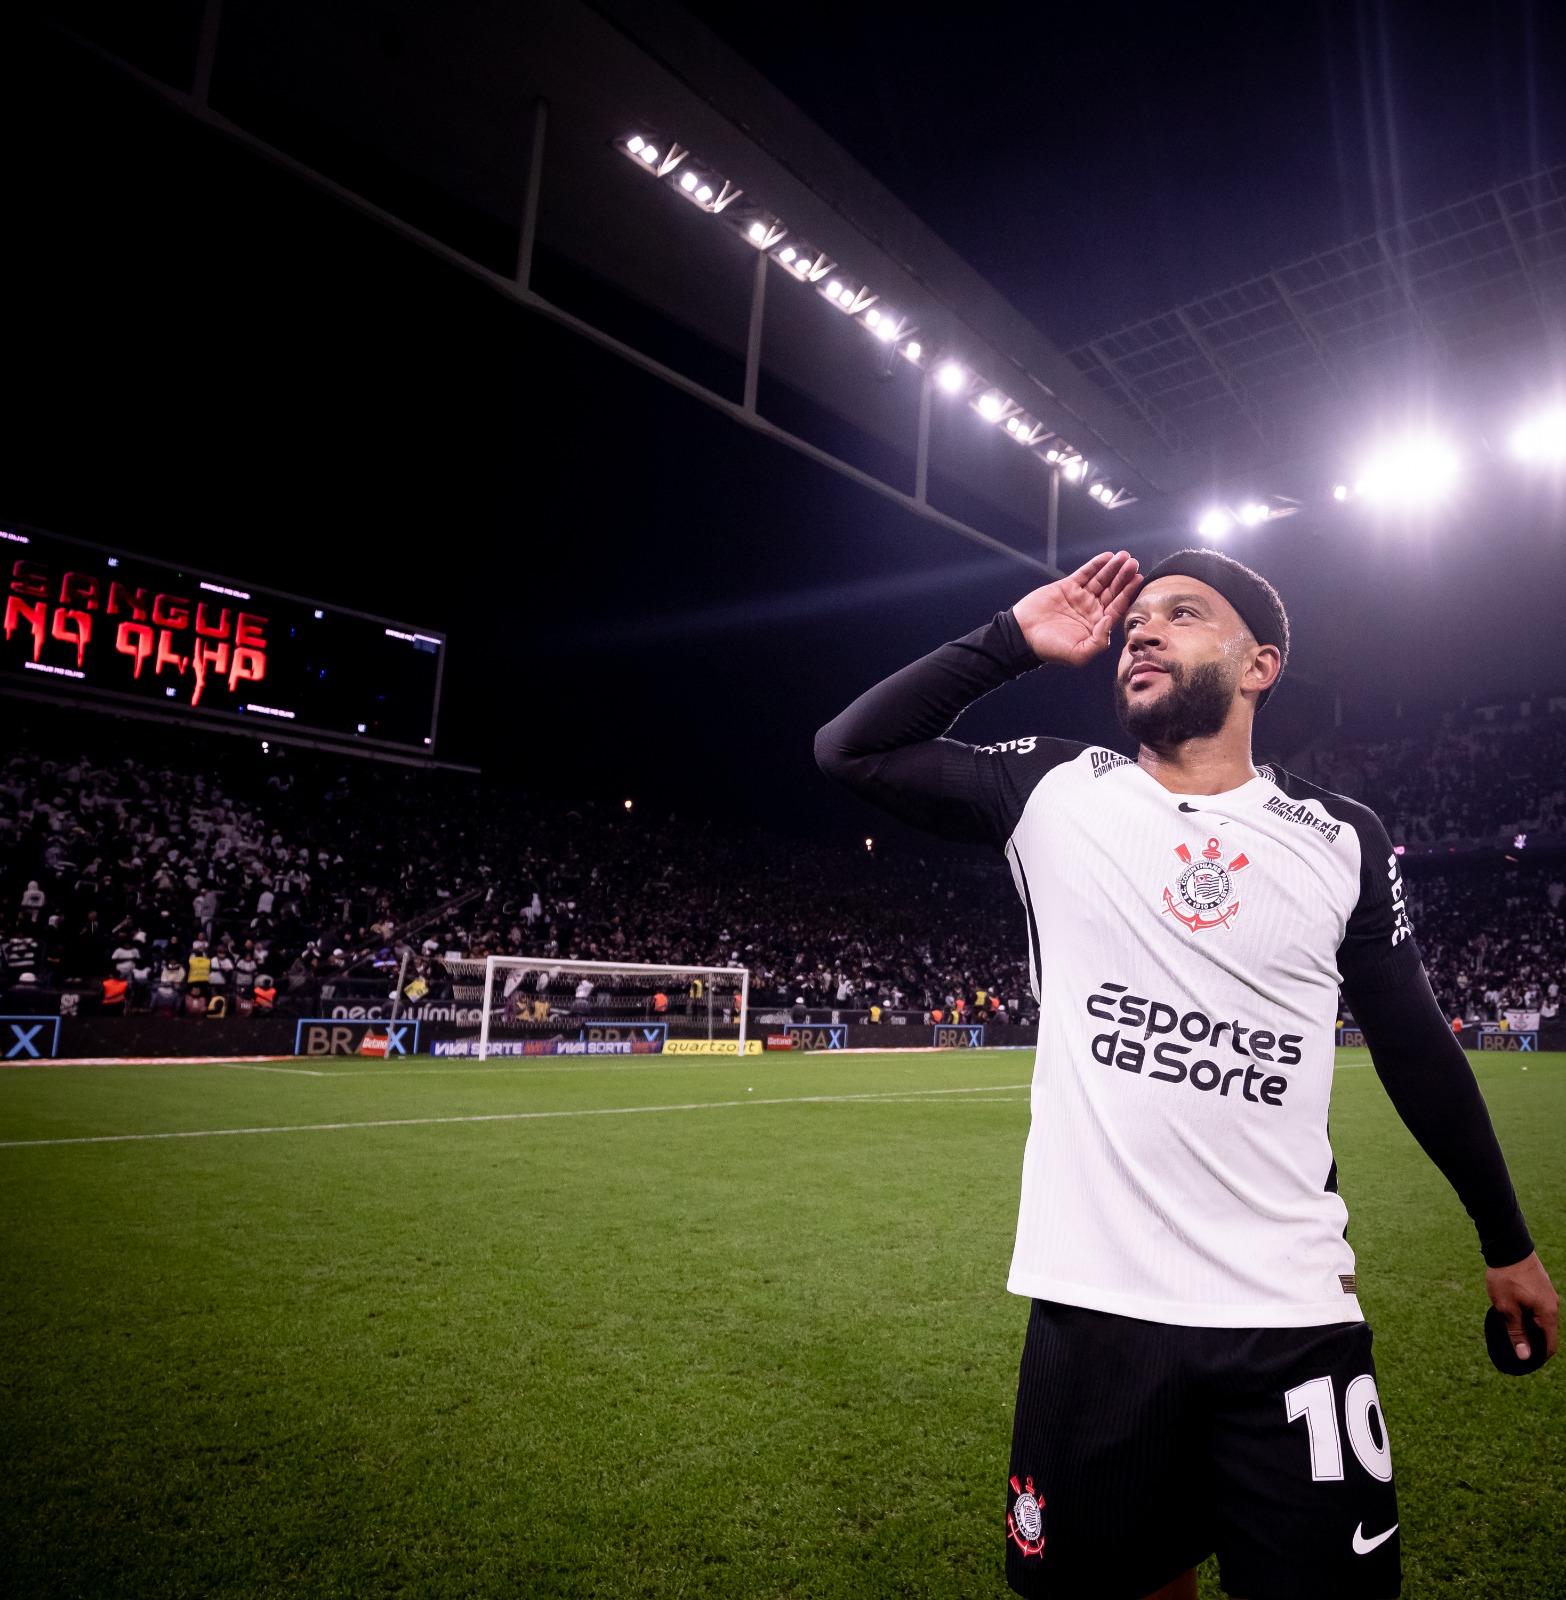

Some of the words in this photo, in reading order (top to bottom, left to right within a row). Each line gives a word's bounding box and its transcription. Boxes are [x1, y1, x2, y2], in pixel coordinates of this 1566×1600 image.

[10, 559, 269, 648] SANGUE
[4, 596, 93, 665] NO
[116, 621, 267, 704] OLHO
[1193, 901, 1209, 910] 1910
[1087, 982, 1304, 1065] Esportes
[767, 1036, 791, 1046] Betano
[790, 1029, 843, 1049] BRAX
[938, 1030, 980, 1047] BRAX
[1483, 1036, 1532, 1051] BRAX
[434, 1042, 468, 1055] VIVA
[557, 1042, 586, 1054] VIVA
[588, 1042, 632, 1054] SORTE
[667, 1041, 755, 1055] quartzot
[1284, 1374, 1393, 1482] 10
